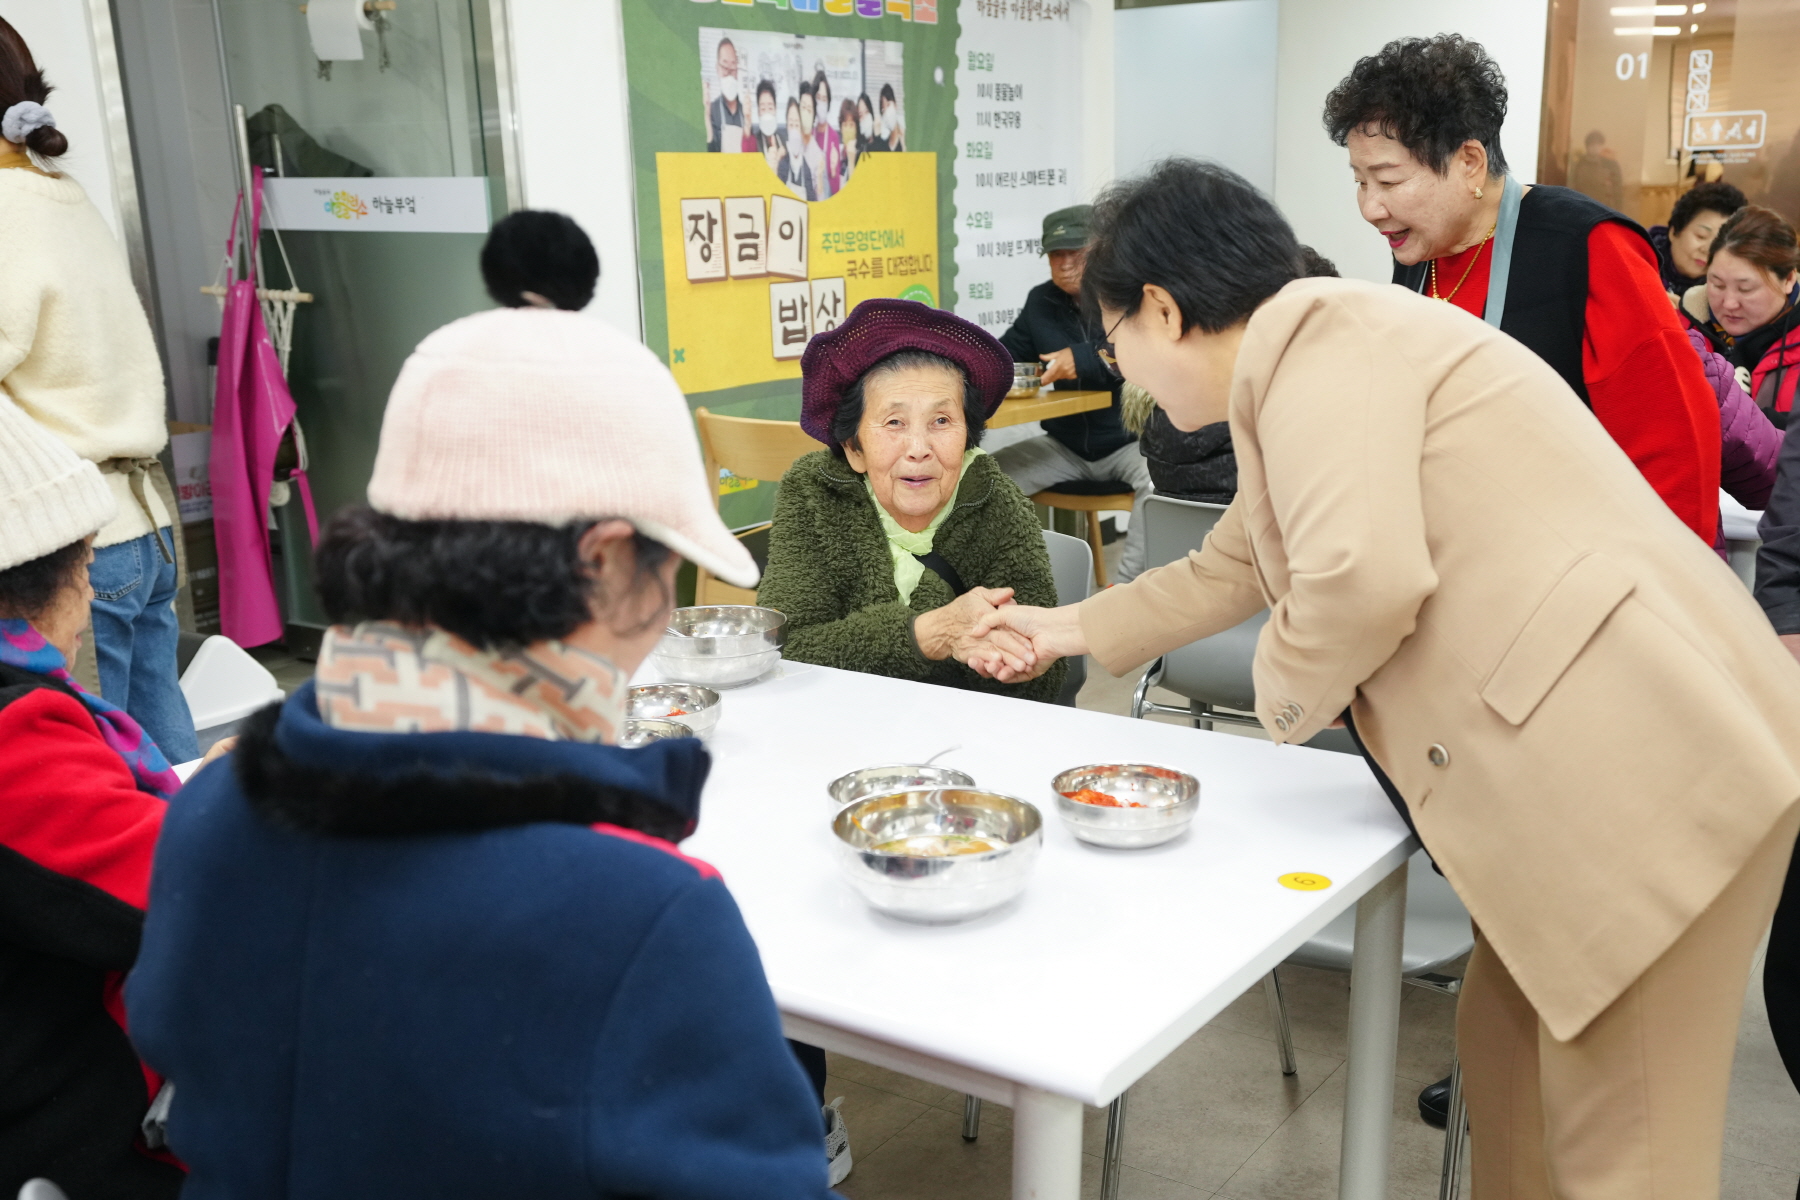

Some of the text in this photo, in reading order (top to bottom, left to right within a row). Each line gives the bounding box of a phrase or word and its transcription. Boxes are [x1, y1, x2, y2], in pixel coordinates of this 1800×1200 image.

[967, 50, 995, 72] 월요일
[1615, 52, 1649, 81] 01
[977, 83, 993, 99] 10시
[976, 111, 1021, 129] 11시 한국무용
[966, 141, 993, 160] 화요일
[975, 172, 993, 188] 10시
[995, 171, 1018, 188] 어르신
[1019, 168, 1056, 186] 스마트폰
[966, 211, 993, 229] 수요일
[687, 209, 804, 264] 장금이
[821, 228, 906, 254] 주민운영단에서
[976, 242, 994, 258] 10시
[996, 240, 1014, 257] 30분
[846, 253, 934, 280] 국수를 대접합니다
[968, 281, 994, 300] 목요일
[778, 289, 842, 346] 밥상
[978, 310, 994, 326] 10시
